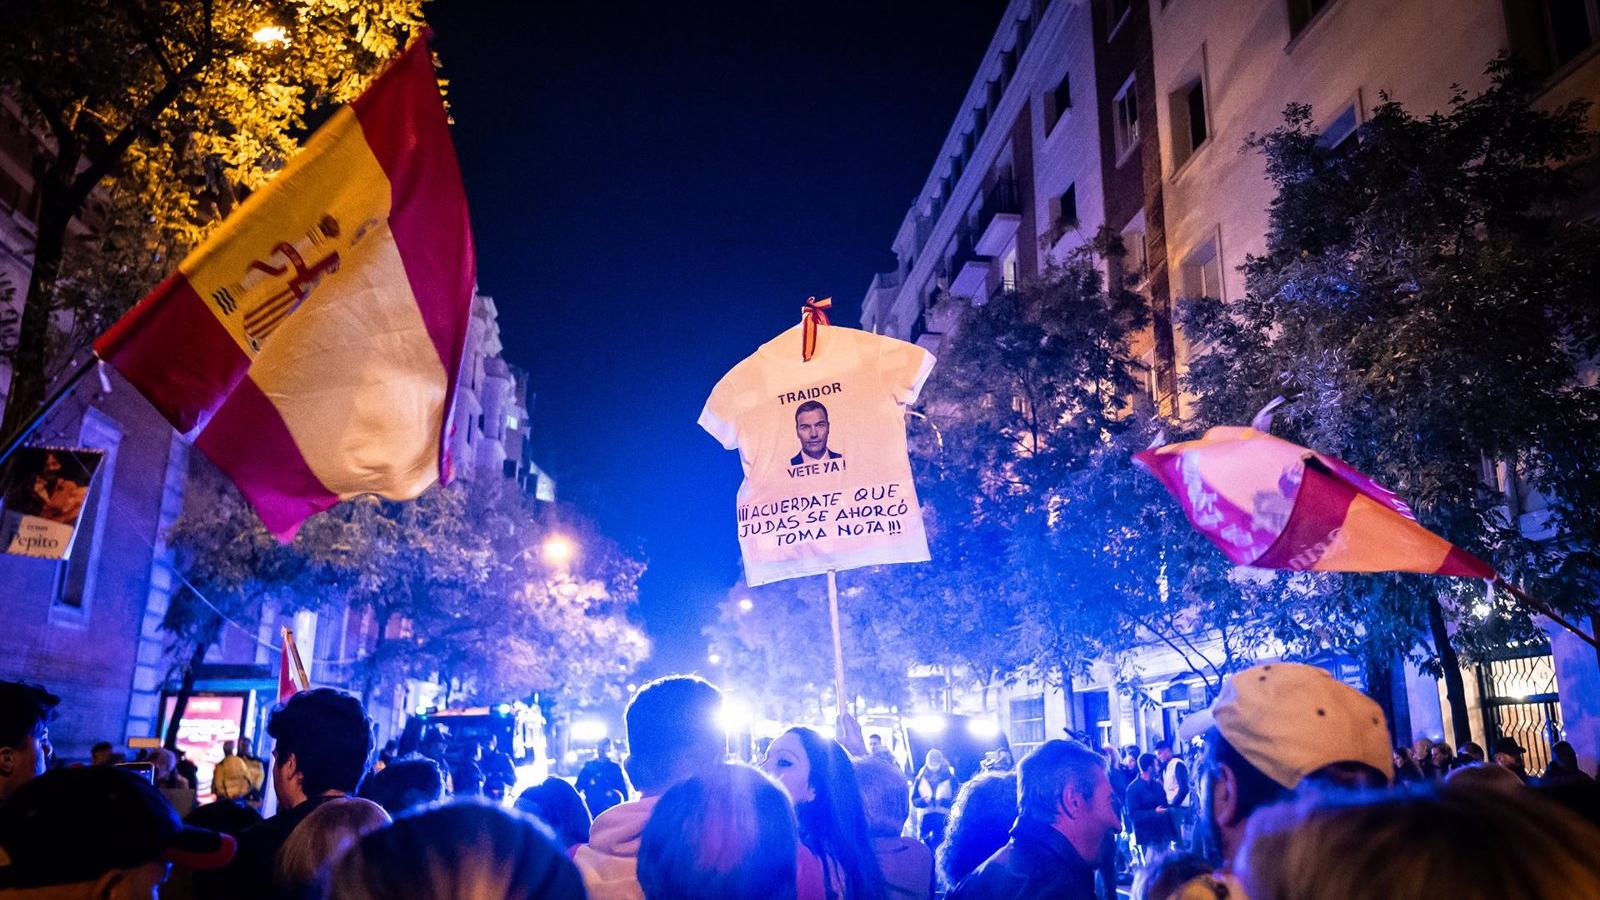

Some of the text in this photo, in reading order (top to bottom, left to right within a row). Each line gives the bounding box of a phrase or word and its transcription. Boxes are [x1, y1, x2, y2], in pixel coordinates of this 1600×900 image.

[778, 382, 843, 405] TRAIDOR
[787, 463, 820, 479] VETE
[854, 483, 900, 502] QUE
[739, 499, 908, 538] JUDAS SE AHORCÓ
[17, 533, 58, 551] epito
[776, 527, 827, 546] TOMA
